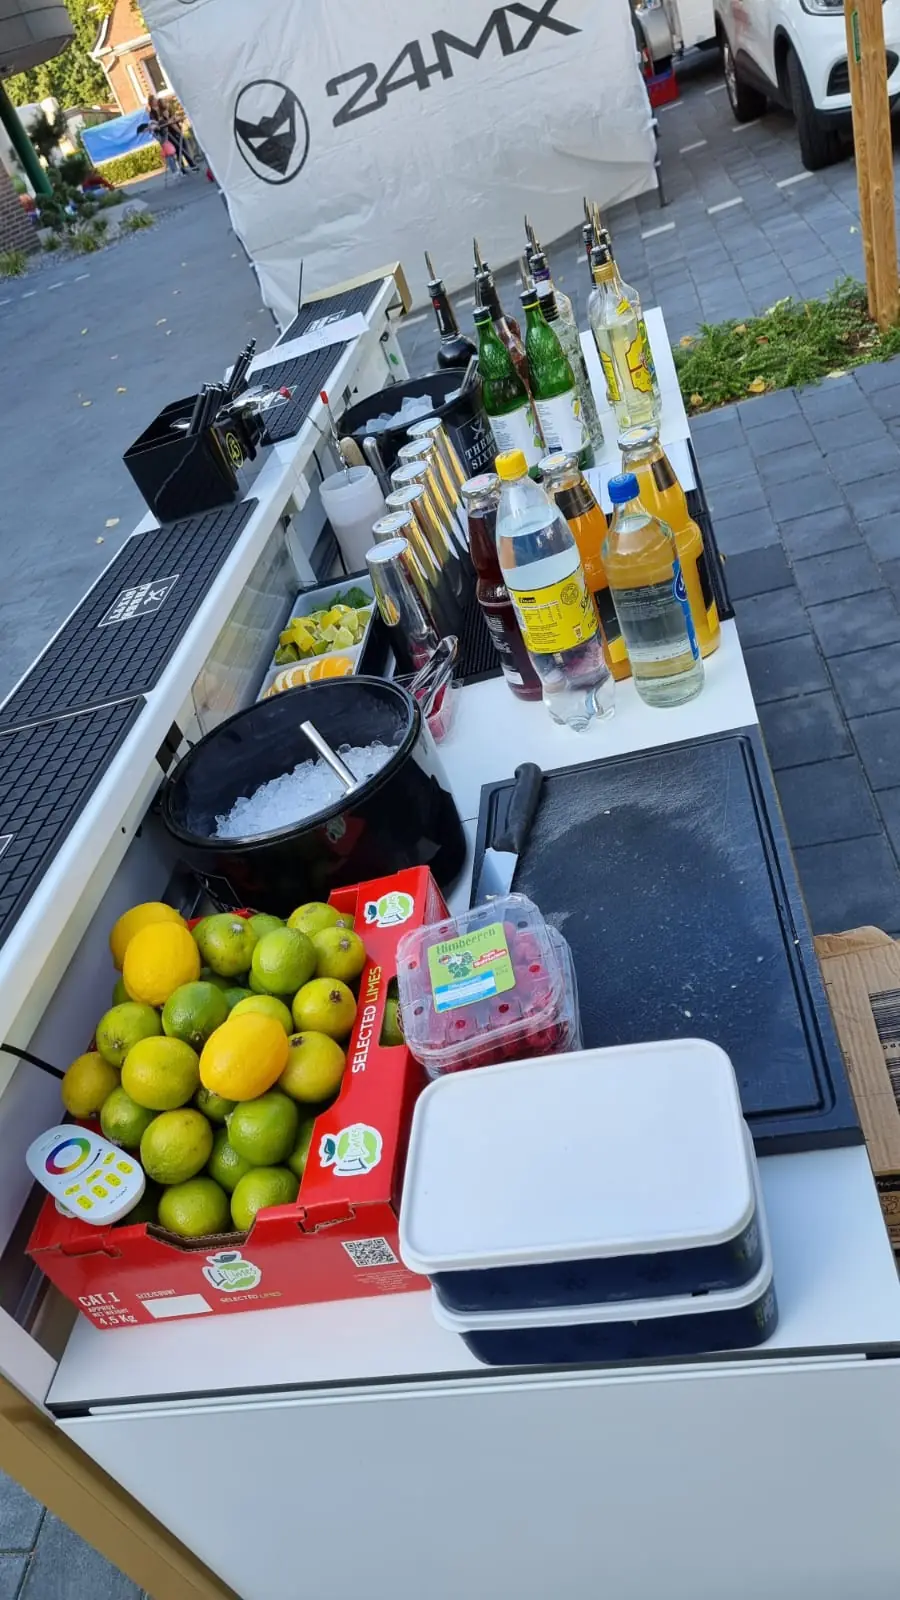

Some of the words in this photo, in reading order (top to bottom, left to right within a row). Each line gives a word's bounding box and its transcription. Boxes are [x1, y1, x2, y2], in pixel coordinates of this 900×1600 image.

[325, 0, 583, 128] 24MX
[436, 927, 496, 955] Himbeeren
[351, 1004, 377, 1073] SELECTED
[365, 966, 382, 1004] LIMES
[219, 1294, 260, 1303] SELECTED
